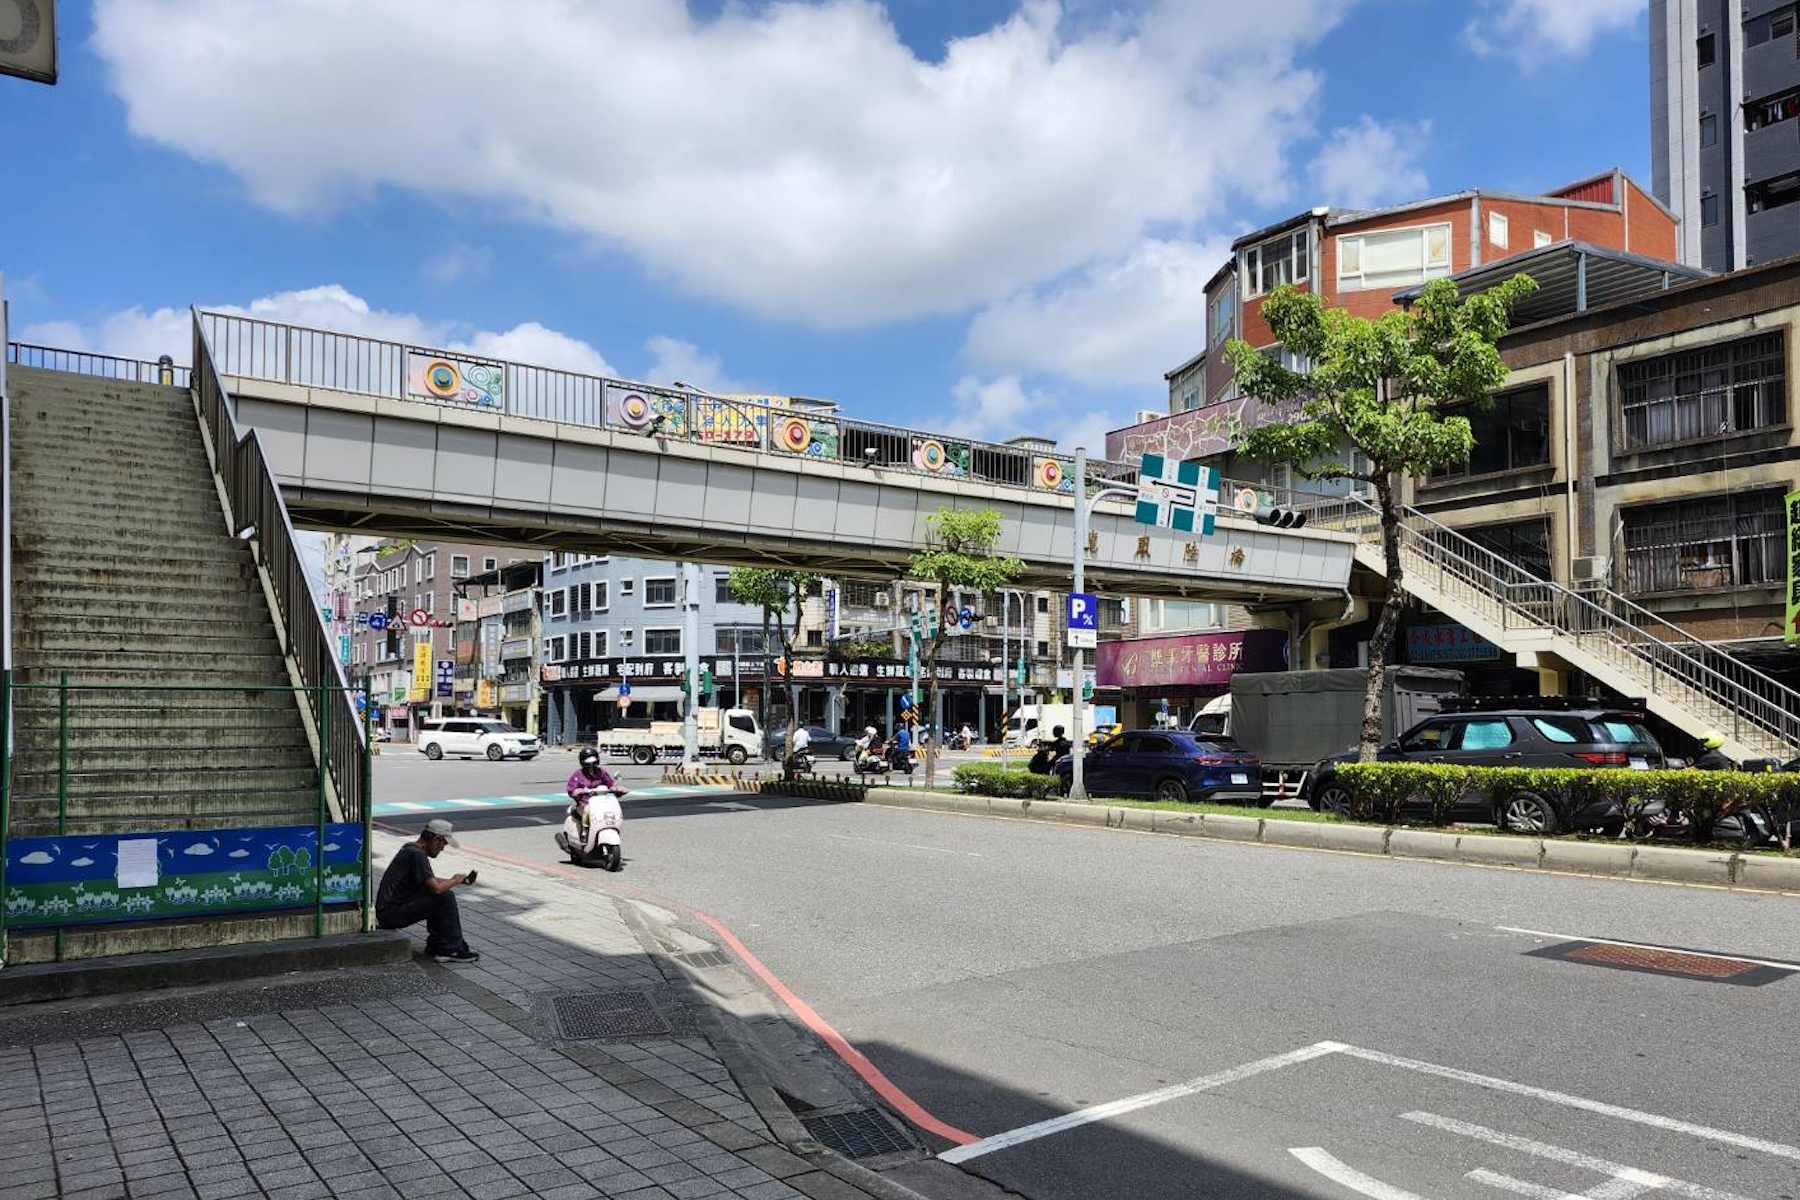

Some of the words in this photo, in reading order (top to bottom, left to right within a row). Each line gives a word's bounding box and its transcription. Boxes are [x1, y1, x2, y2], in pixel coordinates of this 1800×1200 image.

[1072, 598, 1086, 619] P
[662, 661, 711, 676] 客製盒
[876, 664, 912, 678] 生鮮蔬
